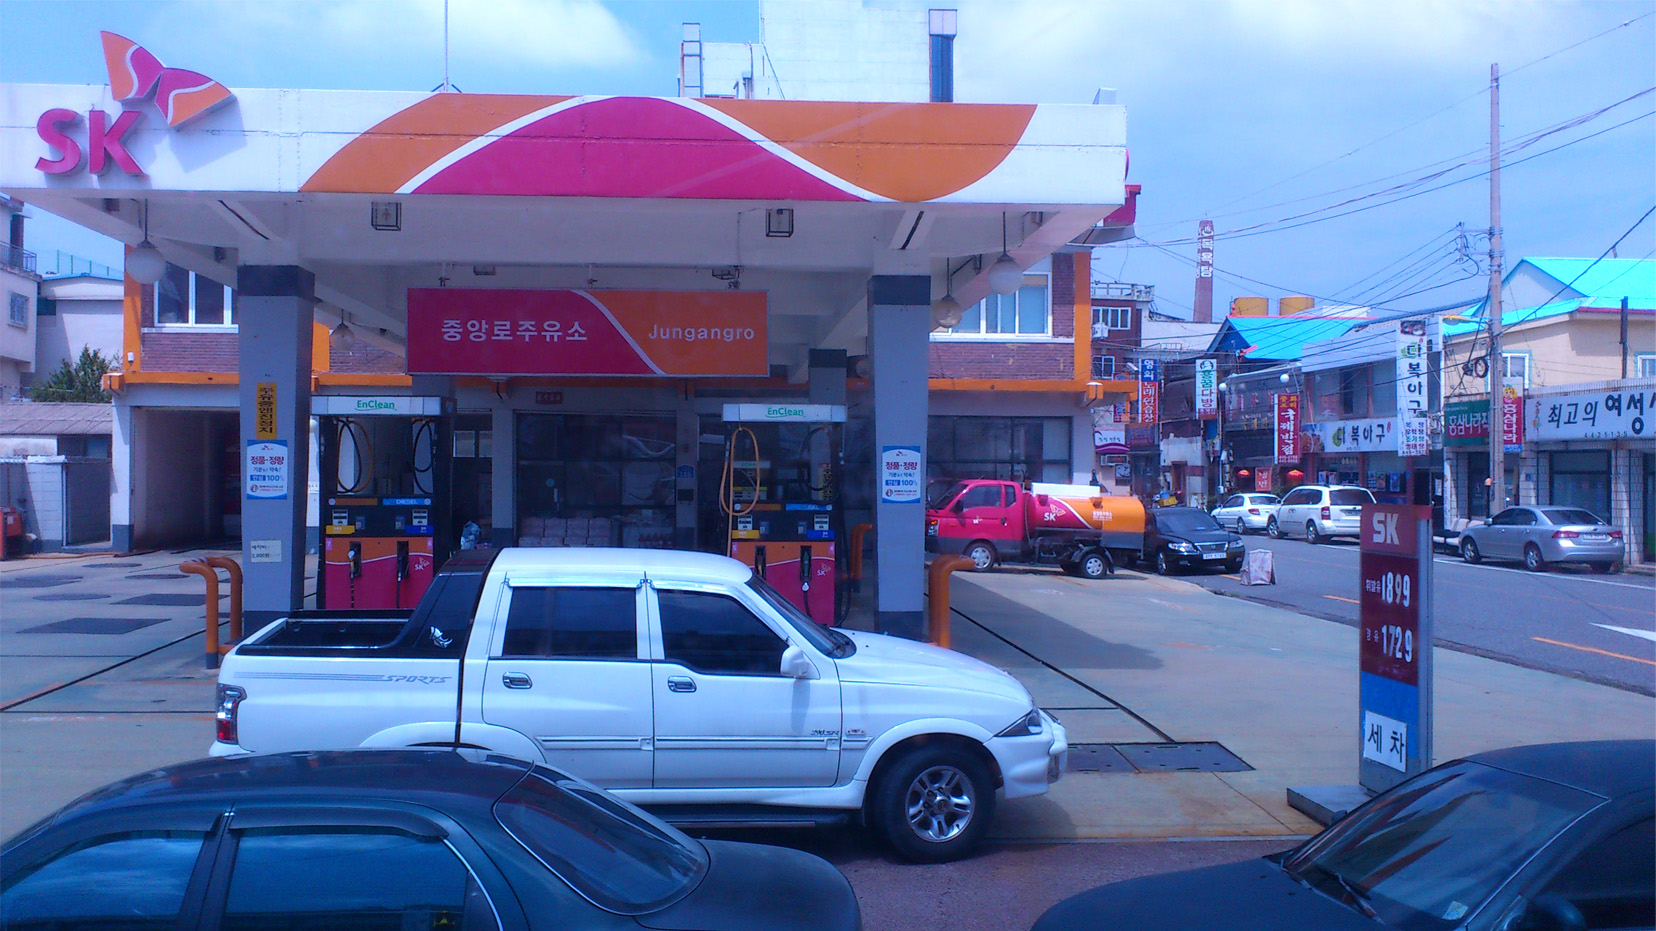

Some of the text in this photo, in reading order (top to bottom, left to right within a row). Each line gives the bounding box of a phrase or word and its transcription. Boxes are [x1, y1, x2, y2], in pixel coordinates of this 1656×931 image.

[35, 108, 144, 175] SK
[441, 319, 588, 343] 중앙로주유소
[648, 323, 755, 343] Jungangro
[356, 399, 396, 409] EnClean
[766, 406, 804, 416] EnClean
[1547, 400, 1599, 428] 최고의
[1503, 403, 1517, 443] 홍삼나라
[1044, 512, 1056, 522] SK
[1372, 512, 1400, 546] SK
[414, 563, 424, 571] SK
[1381, 571, 1411, 608] 1899
[1381, 624, 1413, 663] 1729
[386, 674, 452, 685] SPORTS
